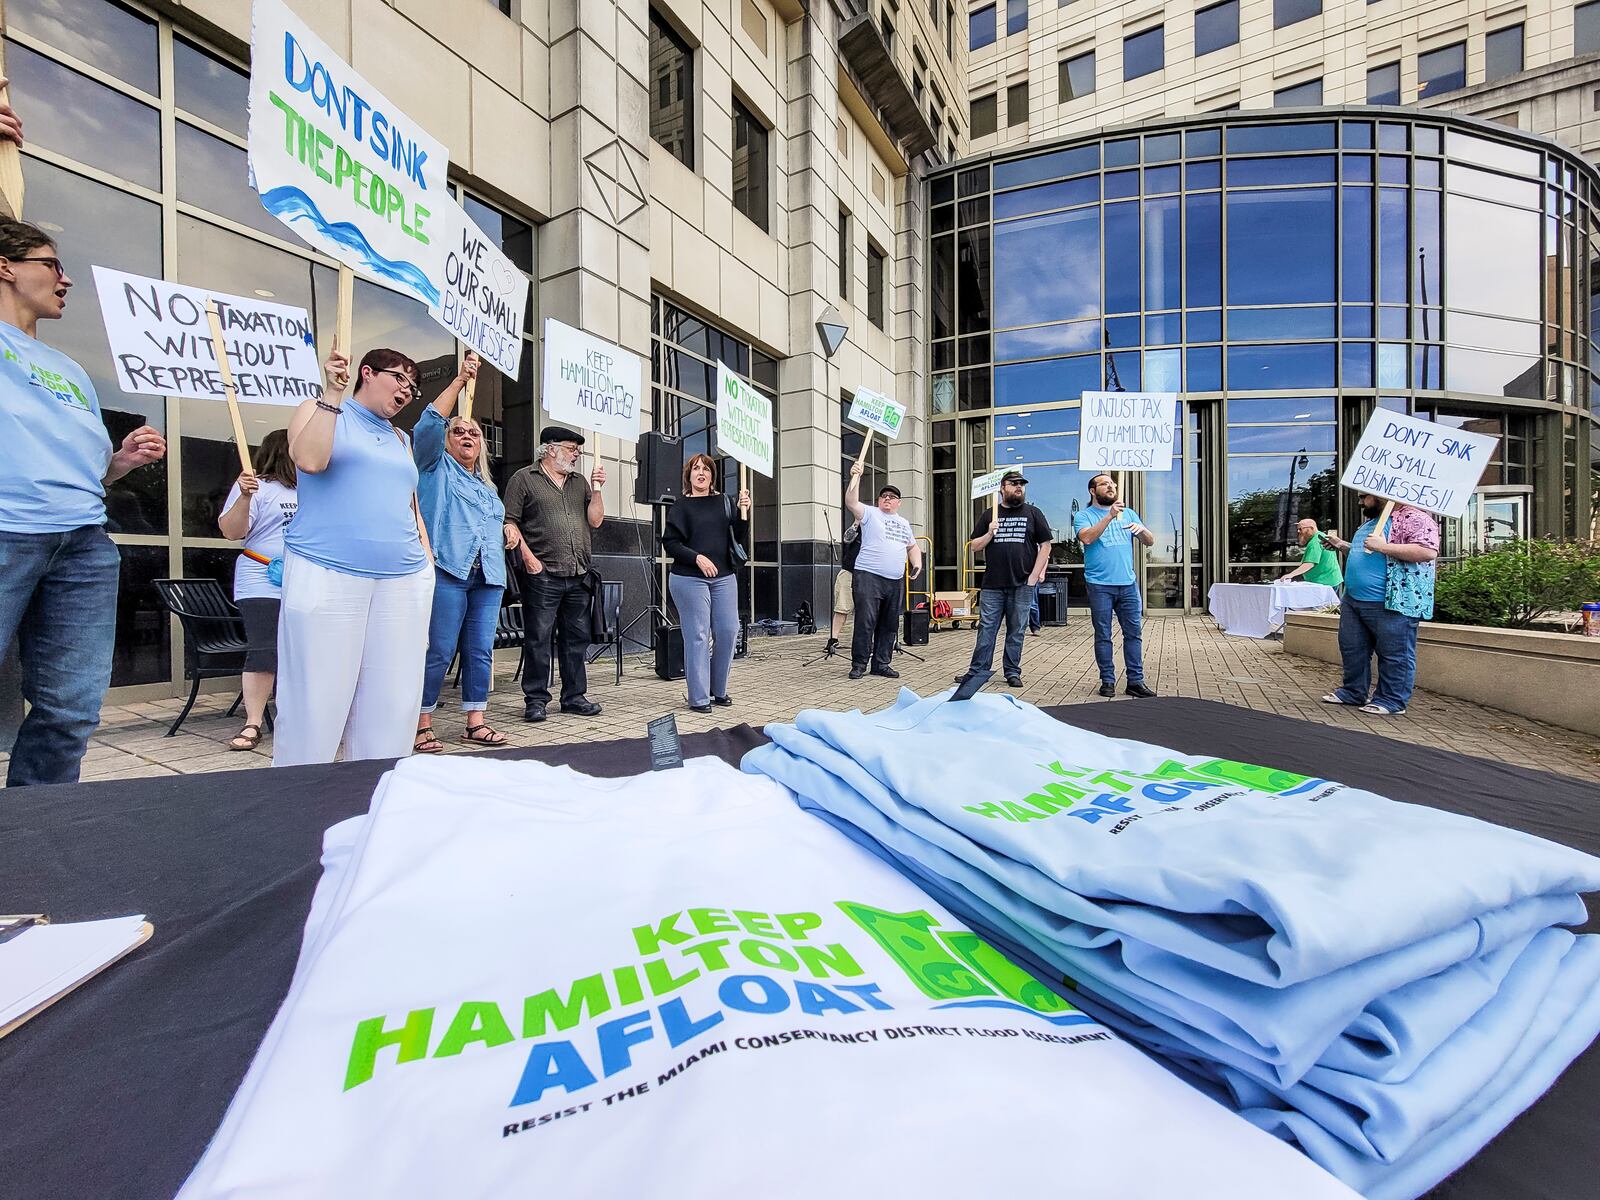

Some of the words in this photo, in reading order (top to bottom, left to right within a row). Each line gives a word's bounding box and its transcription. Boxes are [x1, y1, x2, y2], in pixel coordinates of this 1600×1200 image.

[269, 90, 334, 184] THE
[334, 144, 431, 245] PEOPLE
[369, 110, 428, 190] SINK
[462, 227, 488, 274] WE
[123, 282, 200, 326] NO
[211, 299, 313, 340] TAXATION
[445, 251, 480, 306] OUR
[478, 285, 520, 341] SMALL
[144, 330, 296, 370] WITHOUT
[442, 289, 516, 373] BUSINESSES
[560, 357, 615, 395] HAMILTON
[586, 347, 614, 374] KEEP
[576, 387, 615, 415] AFLOAT
[725, 373, 739, 400] NO
[739, 385, 768, 420] TAXATION
[727, 401, 761, 435] WITHOUT
[860, 408, 881, 422] AFLOAT
[1091, 397, 1138, 419] UNJUST
[1140, 398, 1162, 419] TAX
[1087, 424, 1104, 443] ON
[1106, 422, 1172, 444] HAMILTON'S
[1383, 422, 1434, 449] DON'T
[1436, 438, 1477, 462] SINK
[1095, 446, 1154, 468] SUCCESS!
[1361, 444, 1391, 466] OUR
[1389, 453, 1437, 480] SMALL
[1352, 465, 1454, 512] BUSINESSES!!
[631, 907, 823, 957] KEEP
[342, 938, 866, 1094] HAMILTON
[507, 973, 895, 1109] AFLOAT
[502, 1102, 593, 1139] RESIST
[602, 1081, 650, 1107] THE
[657, 1040, 728, 1086] MIAMI
[734, 1029, 879, 1051] CONSERVANCY
[883, 1024, 962, 1041] DISTRICT
[963, 1026, 1020, 1038] FLOOD
[1021, 1028, 1113, 1045] ASSESSMENT
